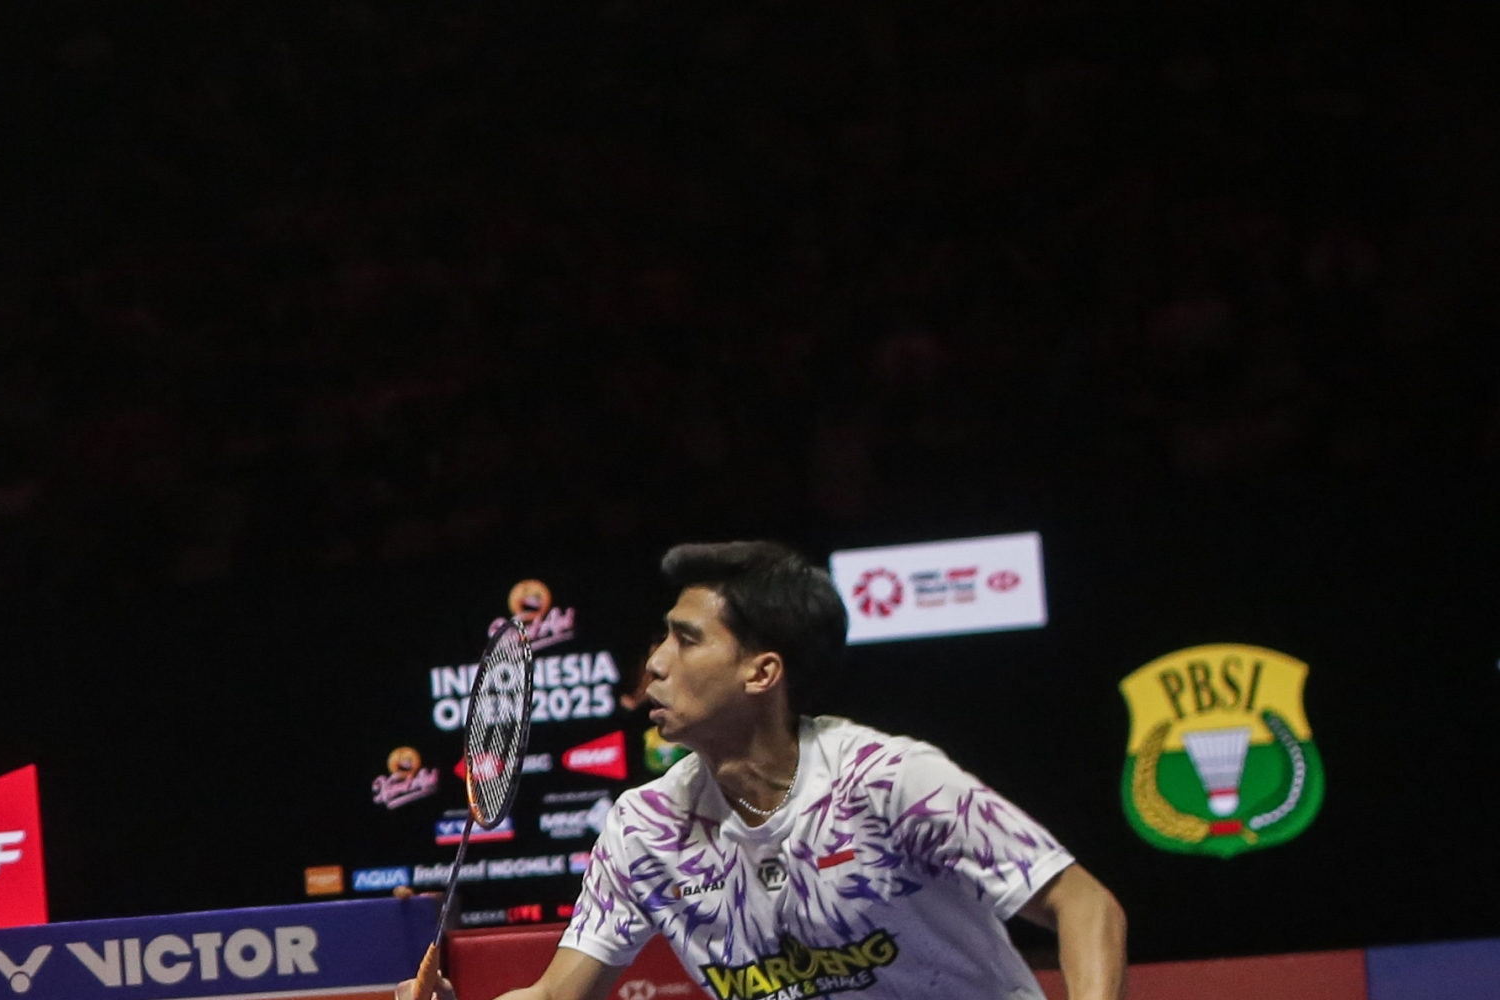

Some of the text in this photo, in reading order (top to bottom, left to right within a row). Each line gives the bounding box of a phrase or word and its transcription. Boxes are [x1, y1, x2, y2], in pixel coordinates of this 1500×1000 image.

[530, 684, 615, 722] 2025
[1159, 657, 1265, 720] PBSI
[355, 868, 408, 888] AQUA
[66, 925, 318, 987] VICTOR
[803, 979, 816, 996] &
